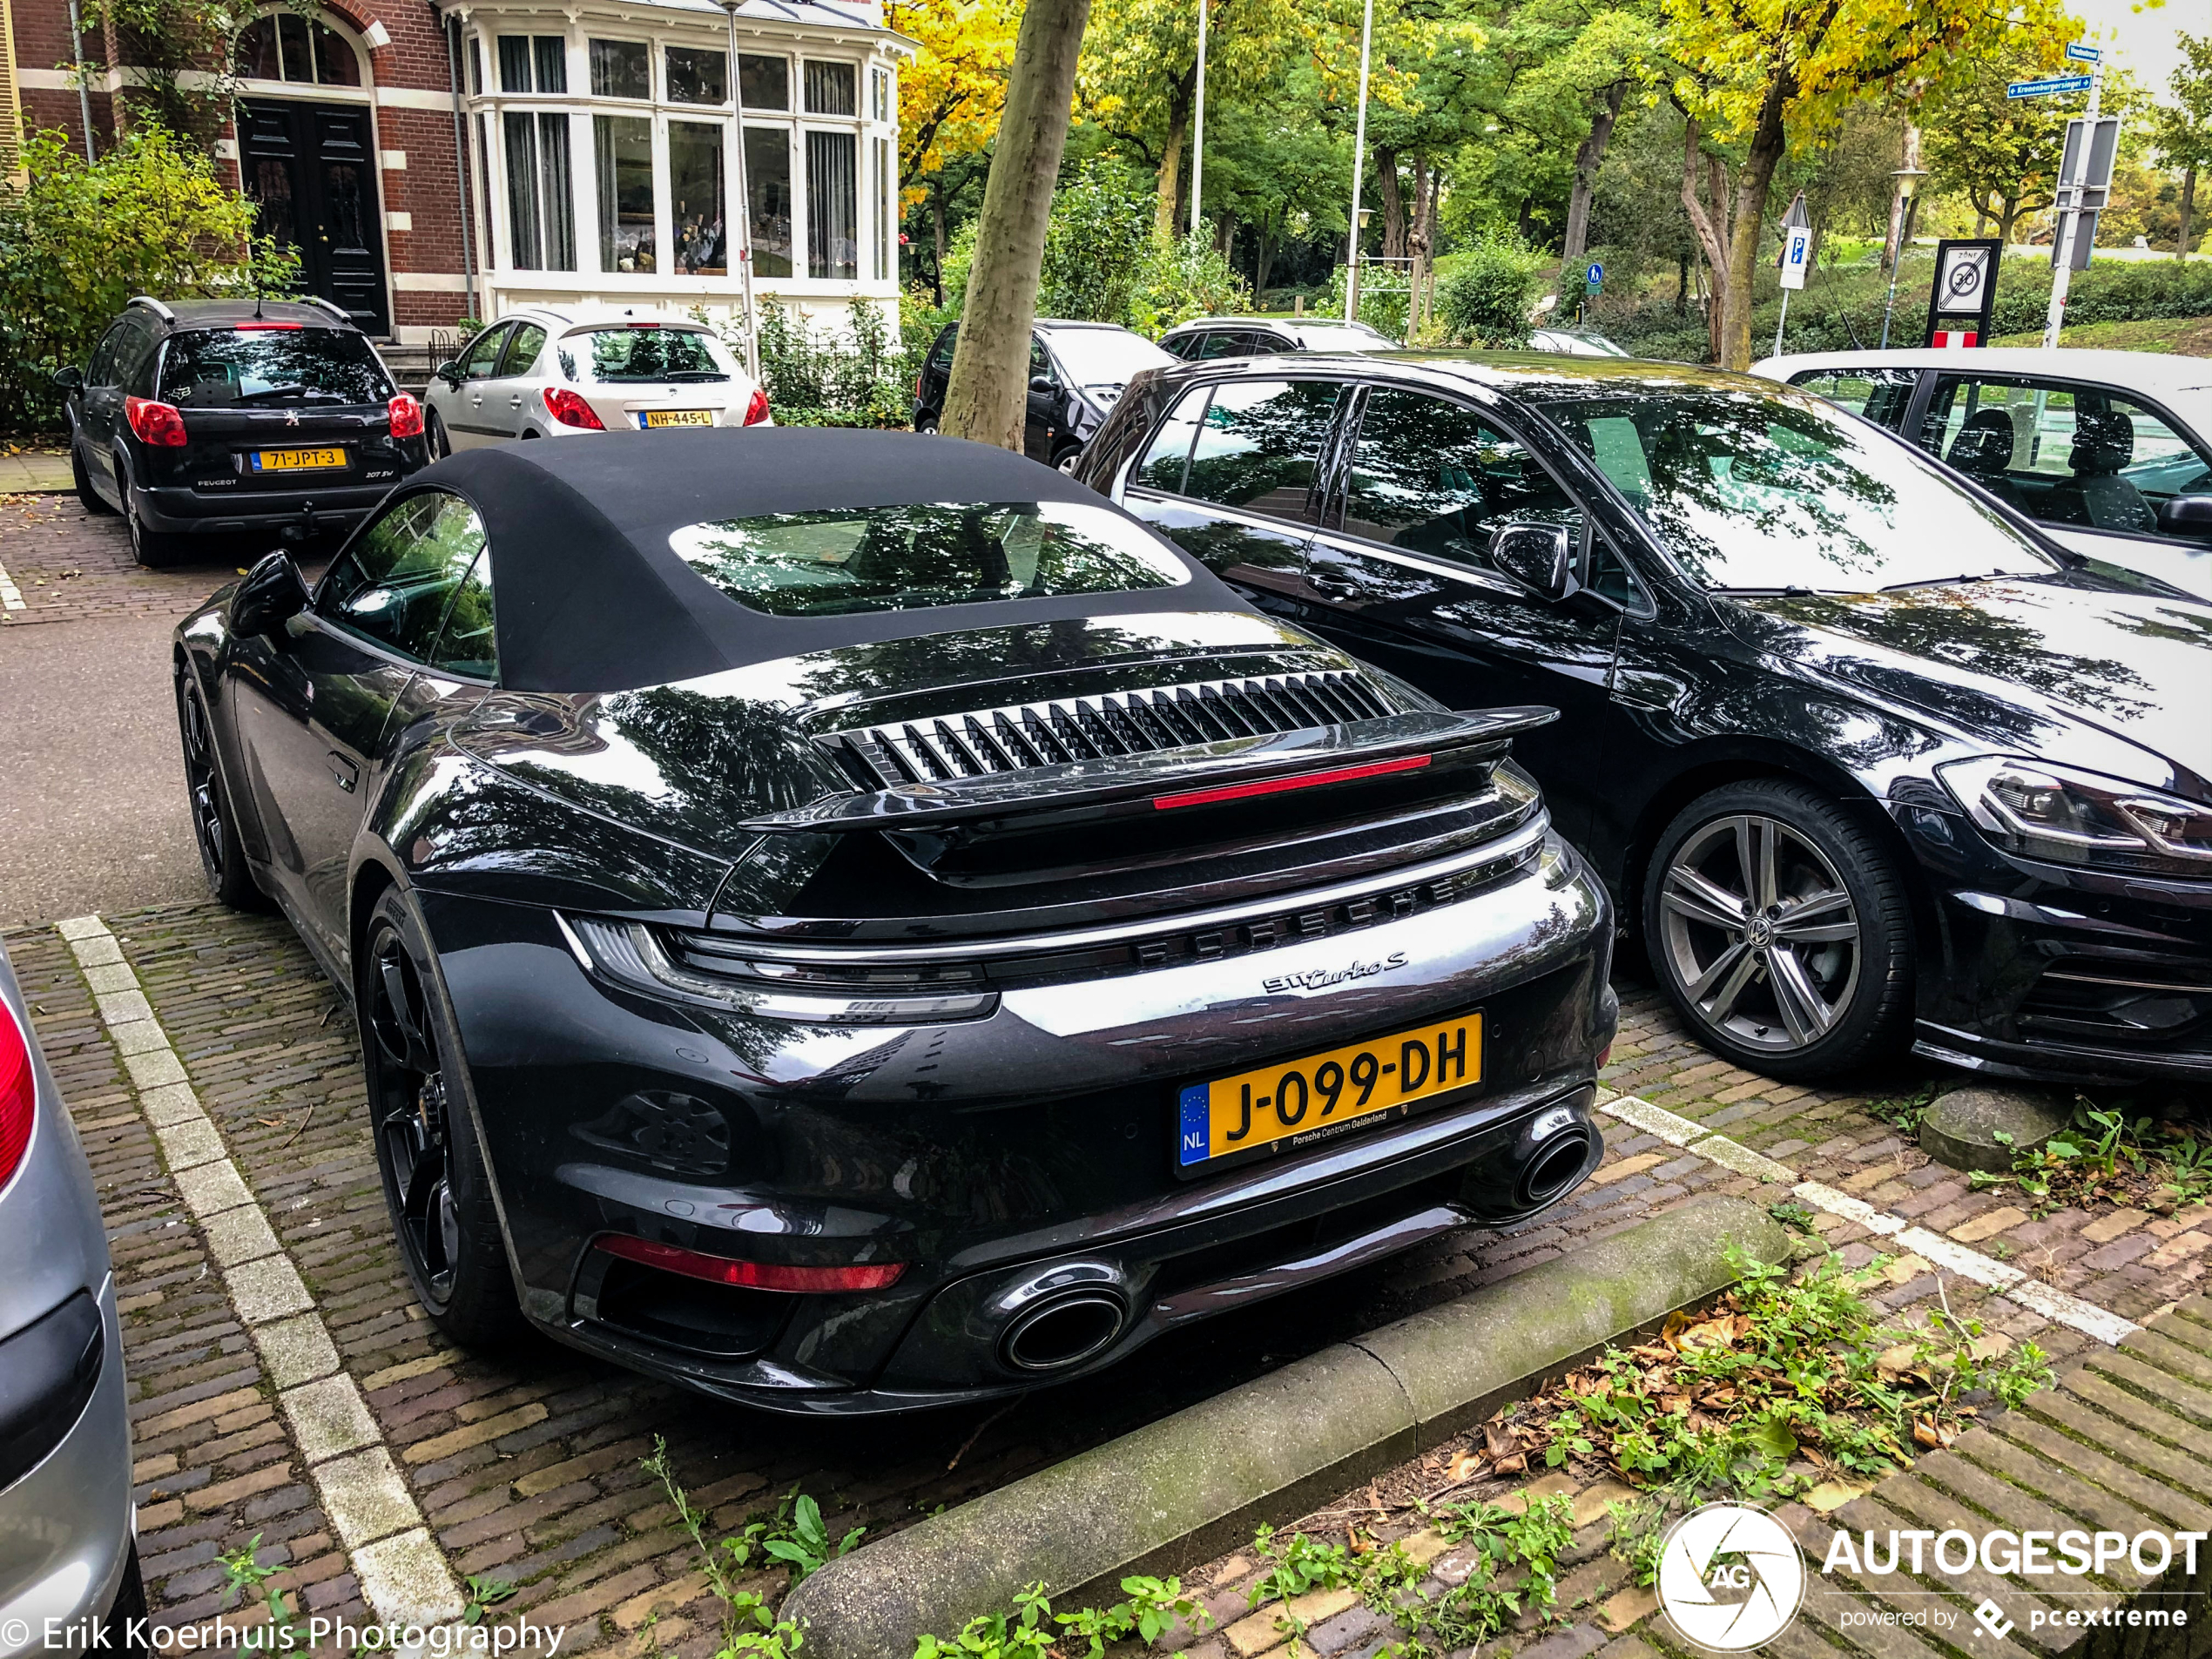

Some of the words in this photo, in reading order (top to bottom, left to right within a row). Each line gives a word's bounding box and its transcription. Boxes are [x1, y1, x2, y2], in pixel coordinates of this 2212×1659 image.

[2017, 79, 2081, 93] Kronenburgersingel
[1954, 273, 1974, 286] 30
[651, 412, 709, 425] NH-445-L
[270, 450, 335, 467] 71-JPT-3
[1136, 879, 1454, 965] PORSCHE
[1383, 951, 1409, 972] S
[1226, 1027, 1467, 1142] J-099-DH
[1292, 1130, 1321, 1147] Porsche
[1322, 1122, 1351, 1138] Centrum
[1351, 1110, 1387, 1130] Gelderland
[1184, 1131, 1205, 1151] NL
